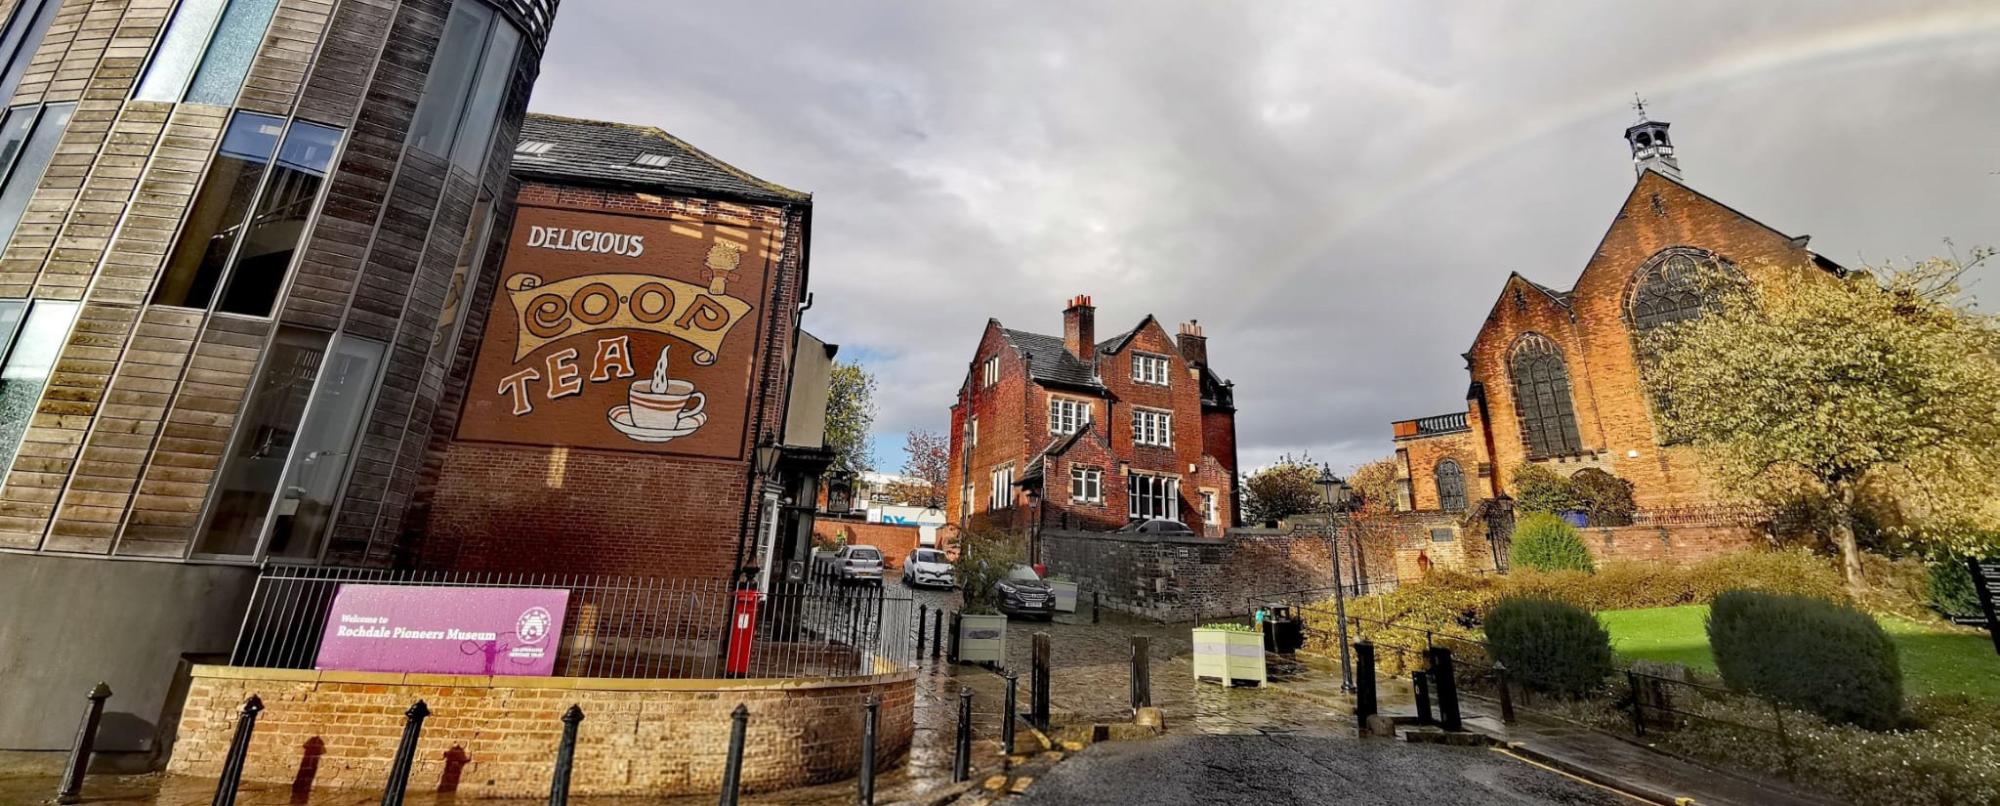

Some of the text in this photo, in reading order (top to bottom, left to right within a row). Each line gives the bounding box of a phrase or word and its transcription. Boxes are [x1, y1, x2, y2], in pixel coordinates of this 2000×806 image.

[526, 225, 645, 258] DELICIOUS
[497, 335, 635, 416] TEA
[341, 613, 390, 624] Welcome to
[337, 625, 497, 641] Rochdale Pioneers Museum
